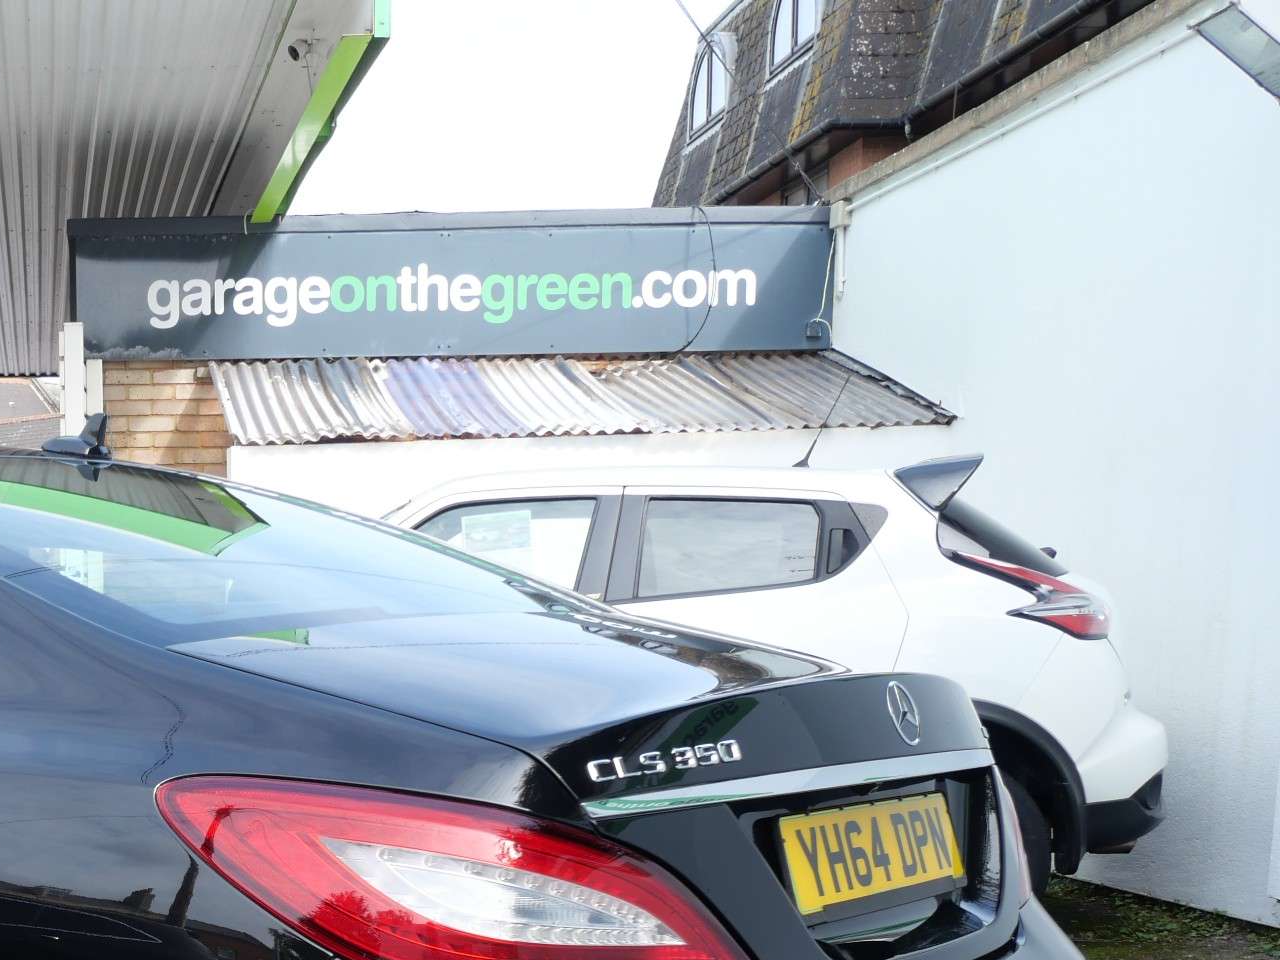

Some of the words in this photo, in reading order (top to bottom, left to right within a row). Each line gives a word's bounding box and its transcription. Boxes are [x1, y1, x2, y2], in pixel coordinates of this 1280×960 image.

[148, 263, 757, 328] garageonthegreen.com
[586, 750, 666, 782] CLS
[671, 739, 743, 769] 350
[796, 820, 892, 897] YH64
[891, 806, 952, 878] DPN
